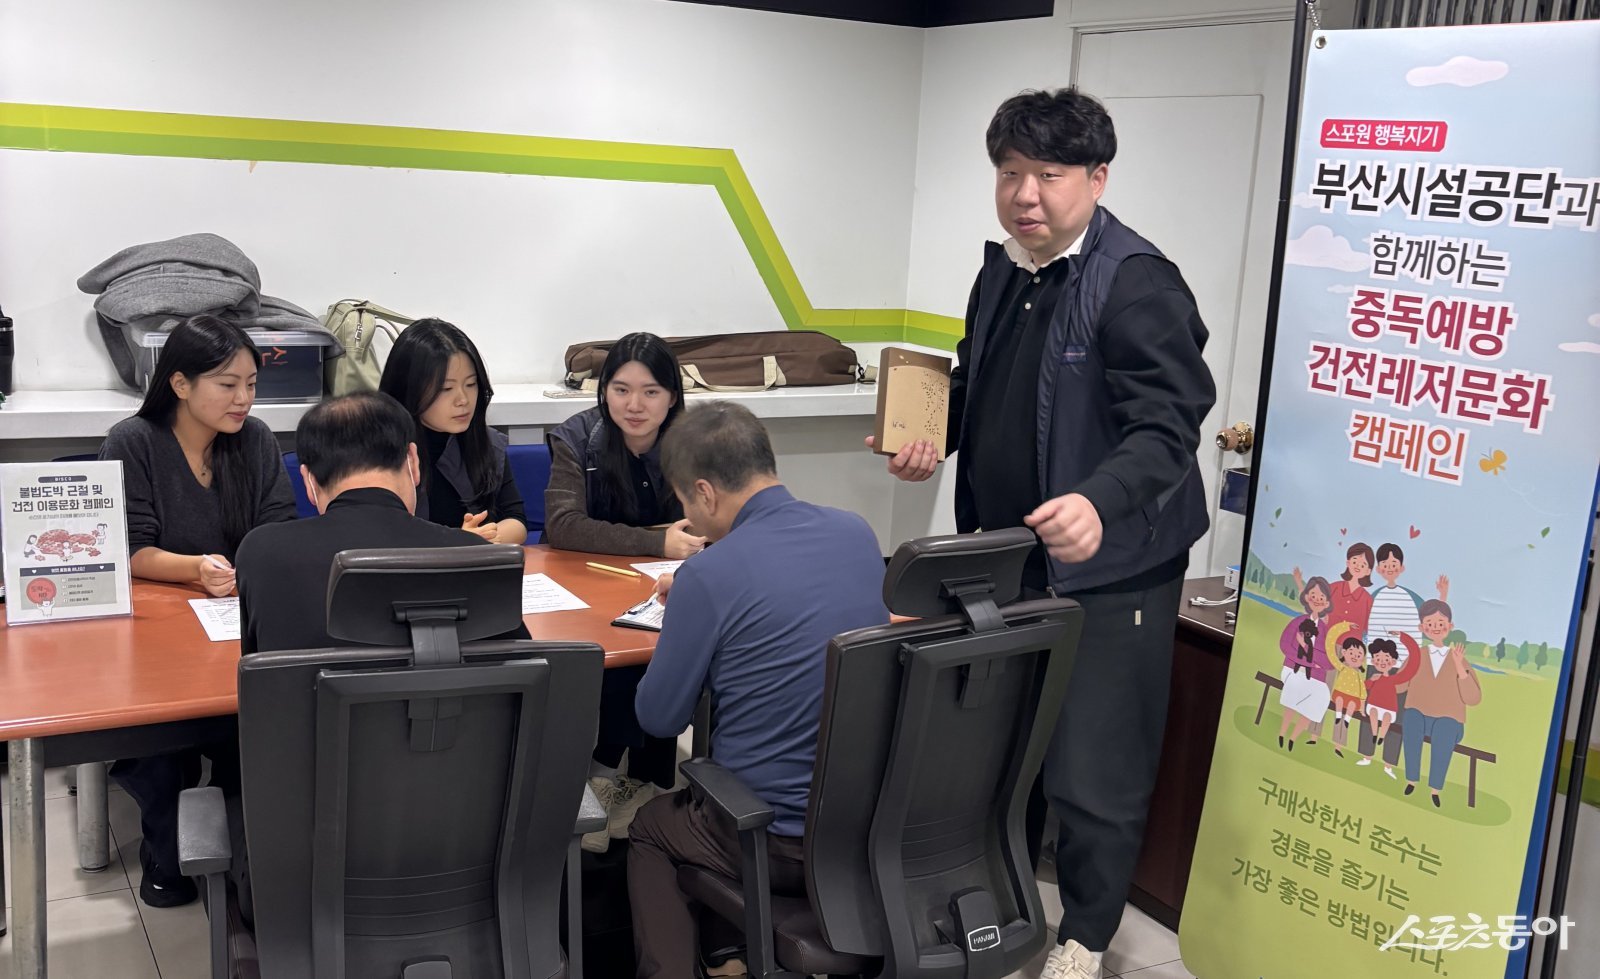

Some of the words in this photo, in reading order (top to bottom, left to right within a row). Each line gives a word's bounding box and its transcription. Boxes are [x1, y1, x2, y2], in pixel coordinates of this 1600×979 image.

[1325, 123, 1371, 145] 스포원
[1374, 124, 1440, 147] 행복지기
[1312, 162, 1600, 228] 부산시설공단과
[1373, 234, 1506, 288] 함께하는
[1349, 288, 1513, 356] 중독예방
[1307, 343, 1550, 430] 건전레저문화
[1349, 413, 1467, 482] 캠페인
[12, 501, 34, 512] 건전
[38, 499, 79, 511] 이용문화
[83, 498, 114, 509] 캠페인
[20, 485, 64, 498] 불법도박
[67, 485, 89, 497] 근절
[92, 484, 103, 495] 및
[1257, 776, 1363, 845] 구매상한선
[1368, 824, 1443, 876] 준수는
[1231, 856, 1273, 894] 가장
[1277, 875, 1320, 917] 좋은
[1270, 828, 1335, 878] 경륜을
[1340, 858, 1411, 911] 즐기는
